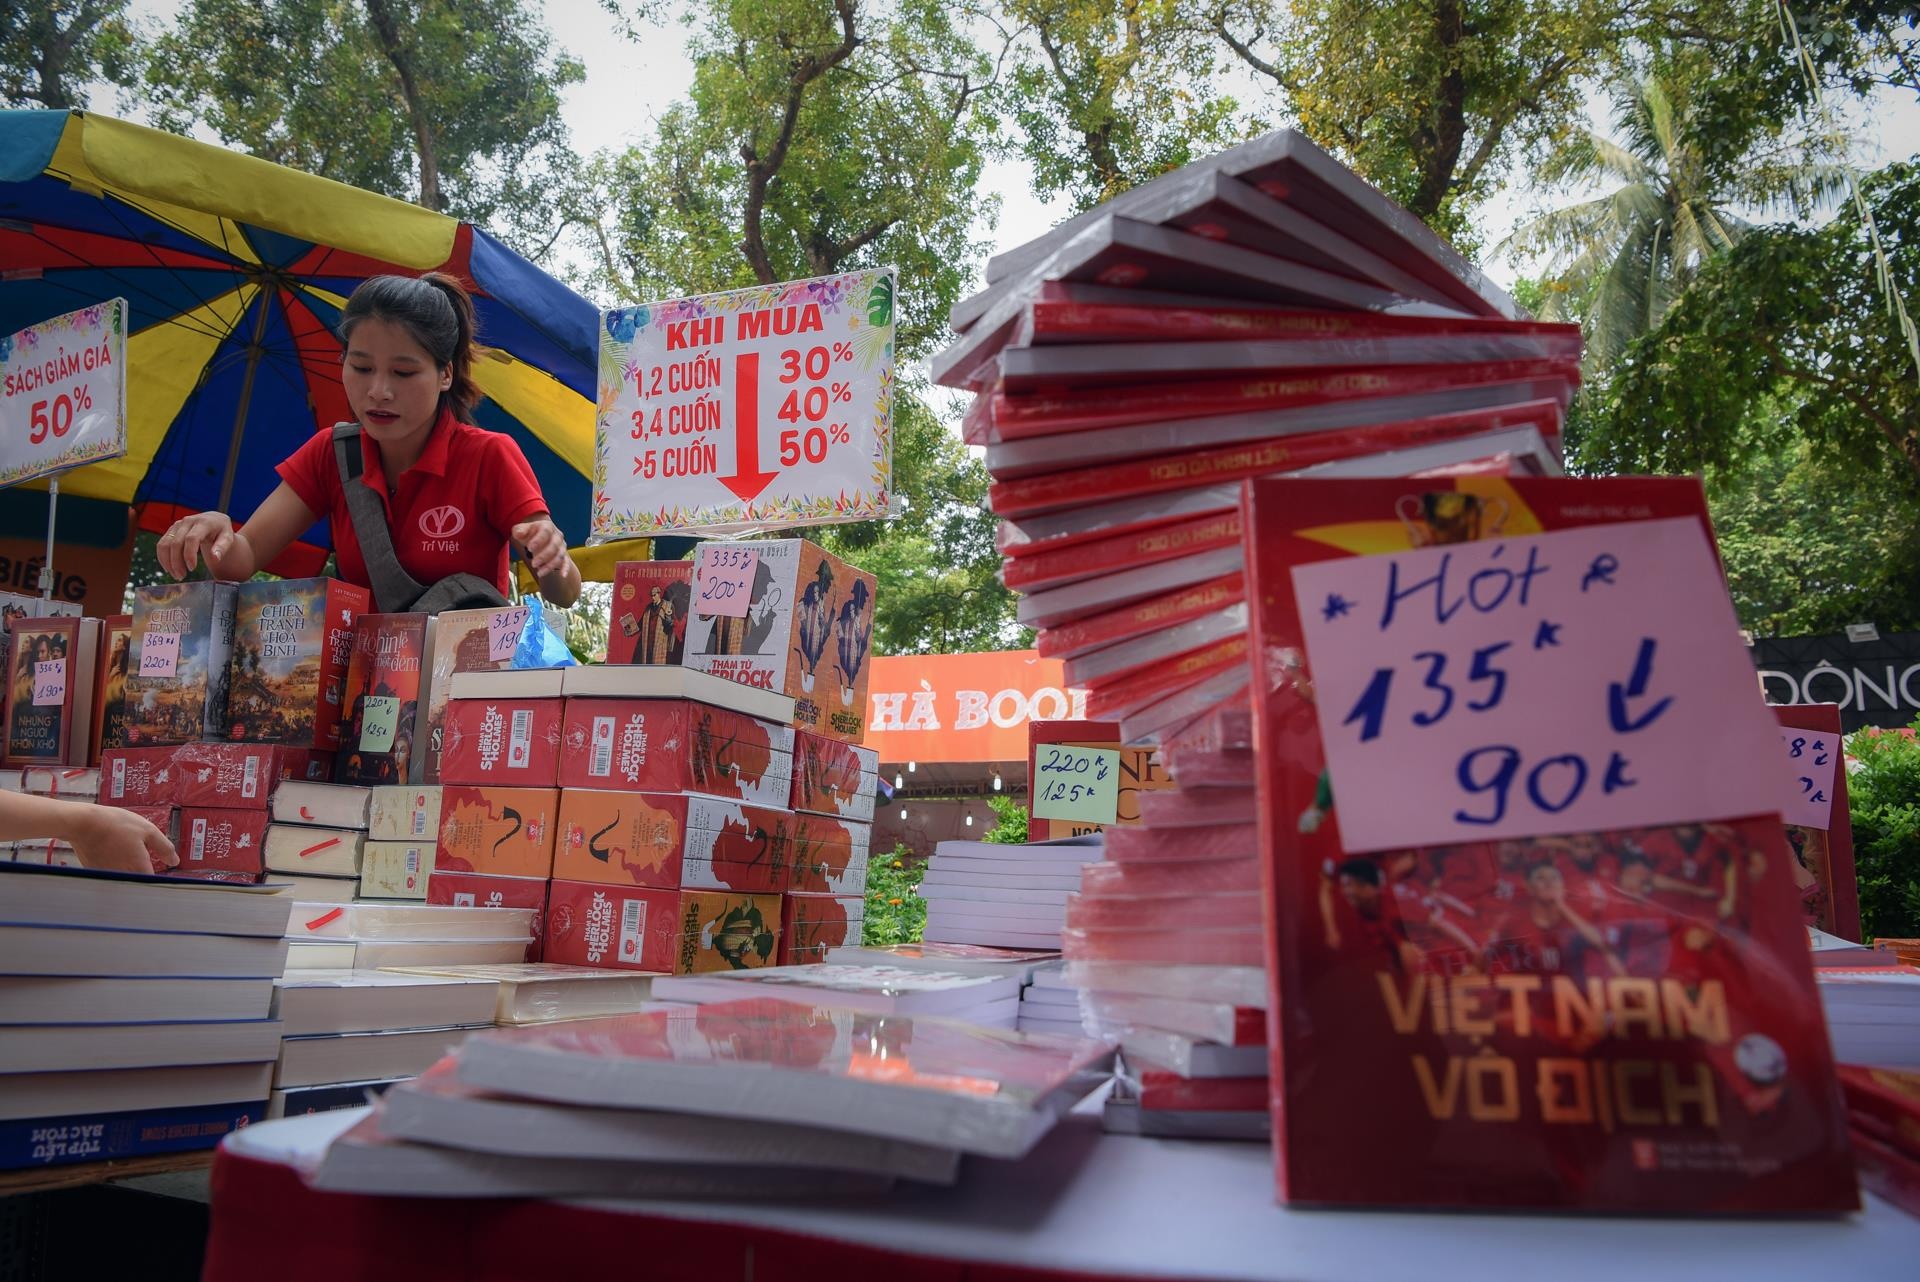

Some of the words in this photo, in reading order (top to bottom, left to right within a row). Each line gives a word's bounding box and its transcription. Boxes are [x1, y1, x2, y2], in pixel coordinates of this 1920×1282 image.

[666, 315, 724, 351] KHI
[737, 303, 824, 340] MUA
[5, 363, 44, 397] SÁCH
[46, 346, 81, 385] GIẢM
[83, 335, 111, 371] GIÁ
[635, 367, 664, 401] 1,2
[669, 350, 722, 395] CUỐN
[779, 342, 854, 385] 30%
[29, 384, 92, 445] 50%
[631, 408, 664, 443] 3,4
[668, 393, 722, 437] CUỐN
[777, 382, 852, 424] 40%
[633, 450, 657, 480] >5
[662, 436, 717, 478] CUỐN
[779, 422, 851, 467] 50%
[421, 540, 436, 551] Trí
[437, 540, 460, 555] Việt
[1379, 544, 1551, 632] Hót
[257, 618, 305, 631] TRANH
[831, 712, 862, 729] SHERLOCK
[870, 678, 941, 732] HÀ
[480, 704, 497, 771] SHERLOCK
[490, 713, 503, 762] HOLMES
[620, 723, 635, 774] HOLMES
[627, 713, 645, 783] SHERLOCK
[1041, 779, 1095, 803] 125k
[1453, 744, 1638, 827] 90k
[587, 891, 606, 964] SHERLOCK
[598, 901, 613, 953] HOLMES
[1374, 971, 1542, 1046] VIỆT
[1551, 974, 1732, 1044] NAM
[1410, 1041, 1519, 1122] VÔ
[1535, 1056, 1722, 1134] ĐỊCH
